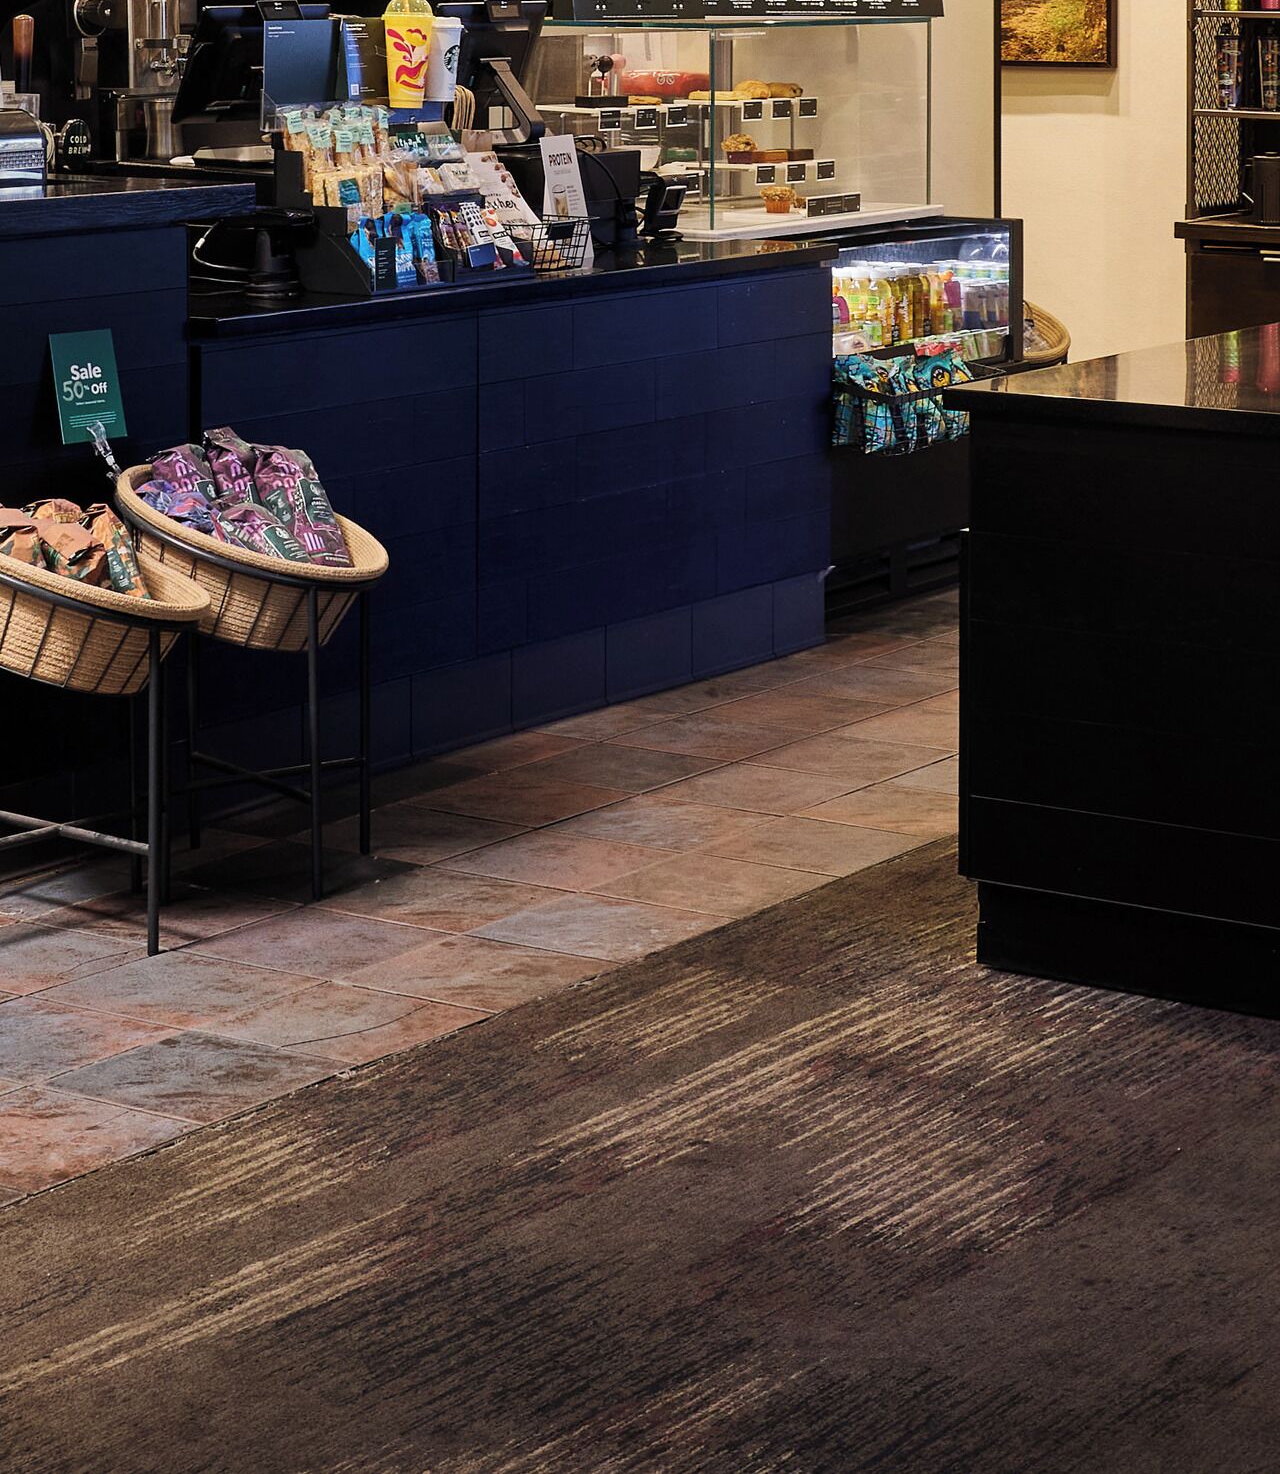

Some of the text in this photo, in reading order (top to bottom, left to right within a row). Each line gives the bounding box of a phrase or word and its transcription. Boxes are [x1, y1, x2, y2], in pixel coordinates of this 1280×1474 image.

[549, 153, 572, 167] PROTEIN
[71, 363, 101, 380] Sale
[91, 382, 107, 394] Off
